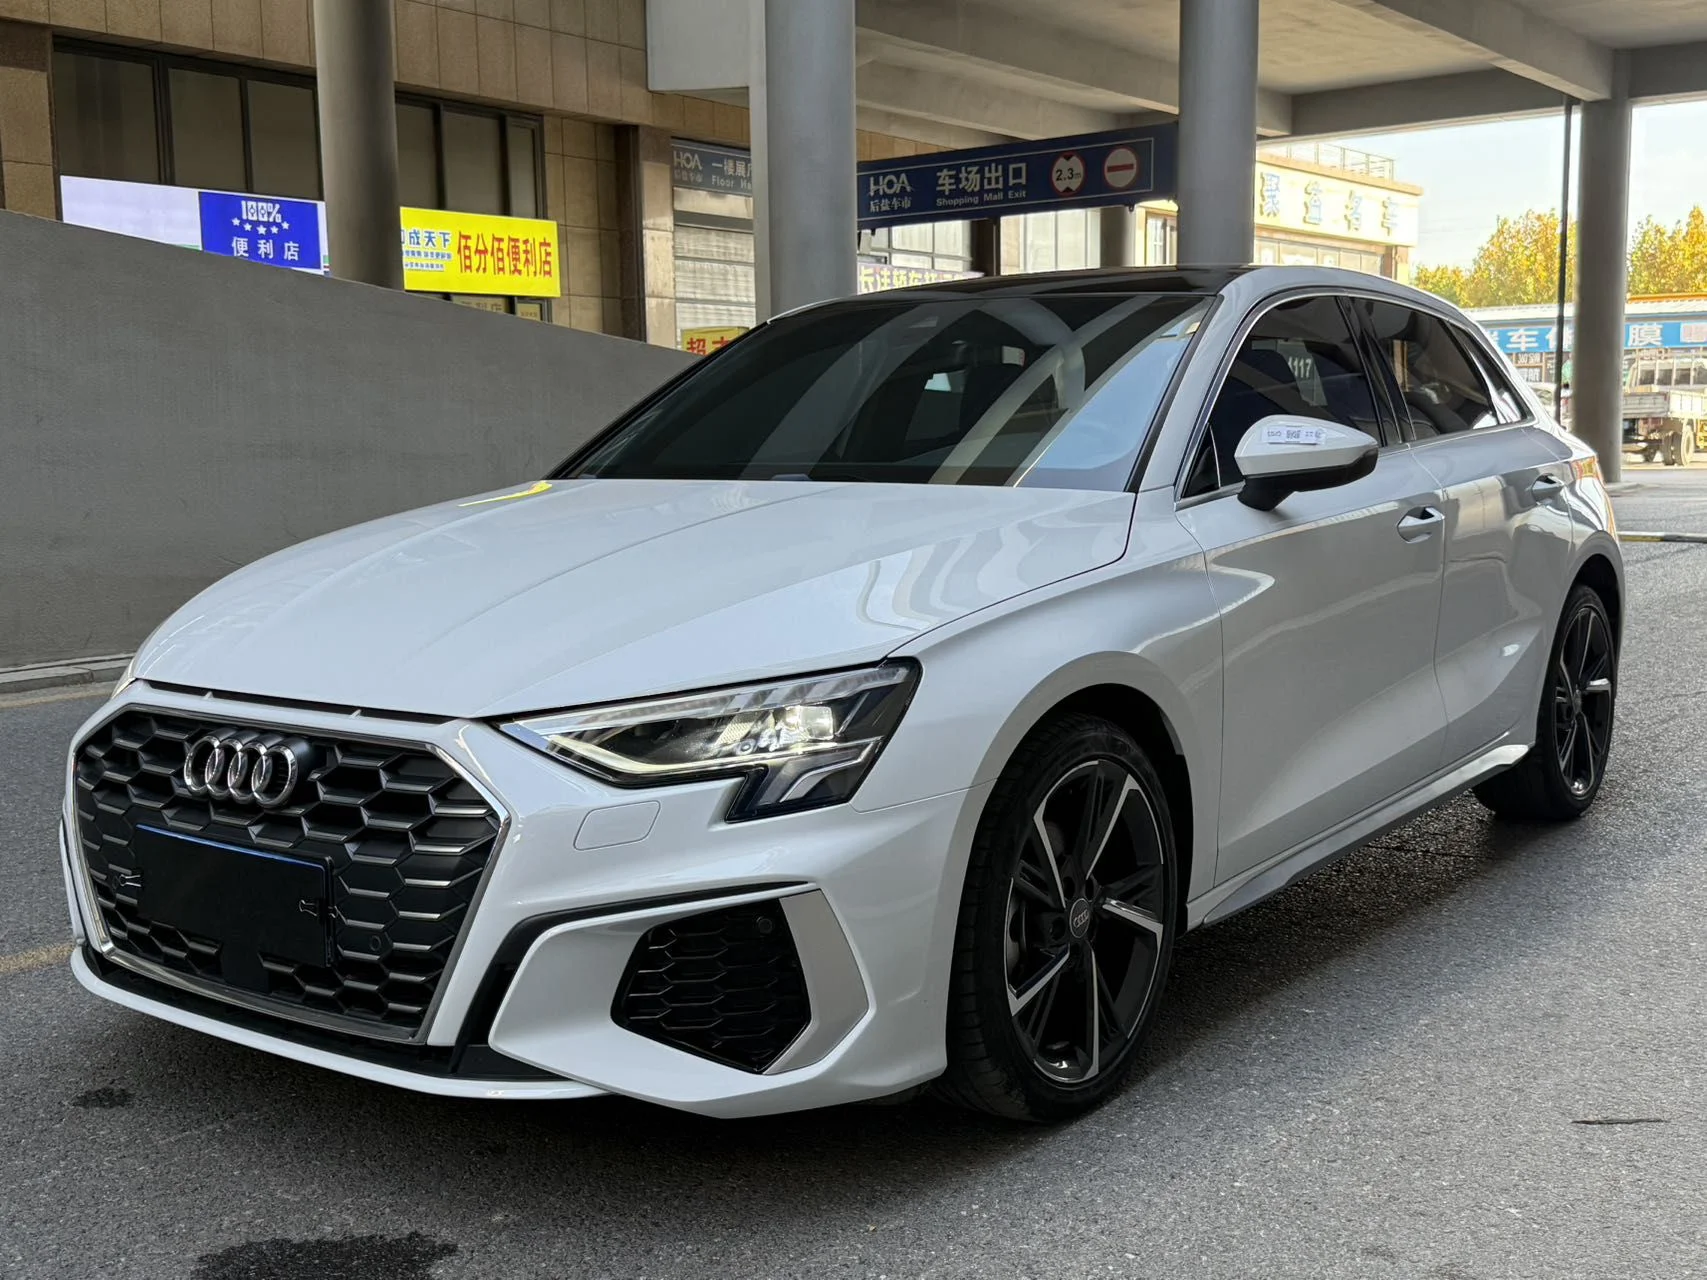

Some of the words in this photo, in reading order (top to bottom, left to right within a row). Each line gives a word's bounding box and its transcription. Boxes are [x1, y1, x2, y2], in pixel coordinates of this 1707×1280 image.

[673, 150, 703, 170] HOA
[711, 158, 752, 178] 一楼展
[711, 175, 734, 188] Floor
[869, 173, 912, 197] HOA
[936, 163, 1027, 195] 车场出口
[936, 195, 979, 207] Shopping
[983, 191, 1003, 202] Mall
[1008, 189, 1027, 199] Exit
[241, 200, 281, 223] 100%
[231, 235, 299, 261] 便利店
[457, 231, 552, 278] 佰分佰便利店
